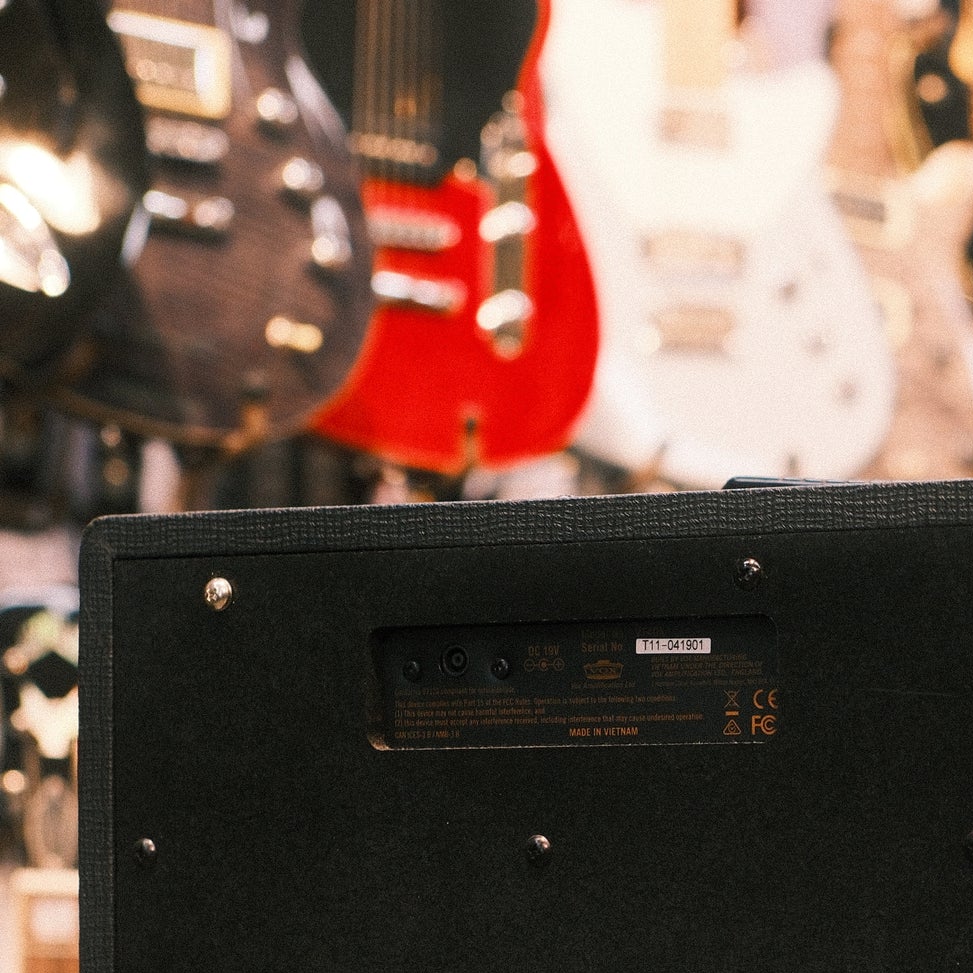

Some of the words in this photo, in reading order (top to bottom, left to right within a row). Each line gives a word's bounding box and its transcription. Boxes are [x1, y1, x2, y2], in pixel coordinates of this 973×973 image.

[528, 645, 540, 656] DC
[544, 645, 560, 656] 19V
[581, 642, 608, 653] Serial
[642, 639, 703, 651] T11-041901
[492, 698, 501, 706] the
[502, 698, 514, 706] FCC
[608, 695, 634, 704] following
[635, 695, 645, 703] two
[753, 689, 778, 709] CE
[416, 709, 434, 718] device
[435, 710, 446, 719] may
[448, 709, 456, 717] not
[475, 708, 497, 716] harmful
[395, 719, 403, 728] (2)
[416, 718, 433, 726] device
[435, 718, 448, 726] must
[450, 718, 468, 727] accept
[469, 719, 479, 727] any
[480, 717, 513, 725] interference
[540, 715, 567, 725] including
[568, 715, 601, 724] interference
[602, 714, 615, 723] that
[616, 715, 628, 724] may
[647, 713, 675, 722] undesired
[395, 731, 406, 740] CAN
[569, 727, 591, 737] MADE
[593, 727, 601, 736] IN
[603, 726, 638, 736] VIETNAM
